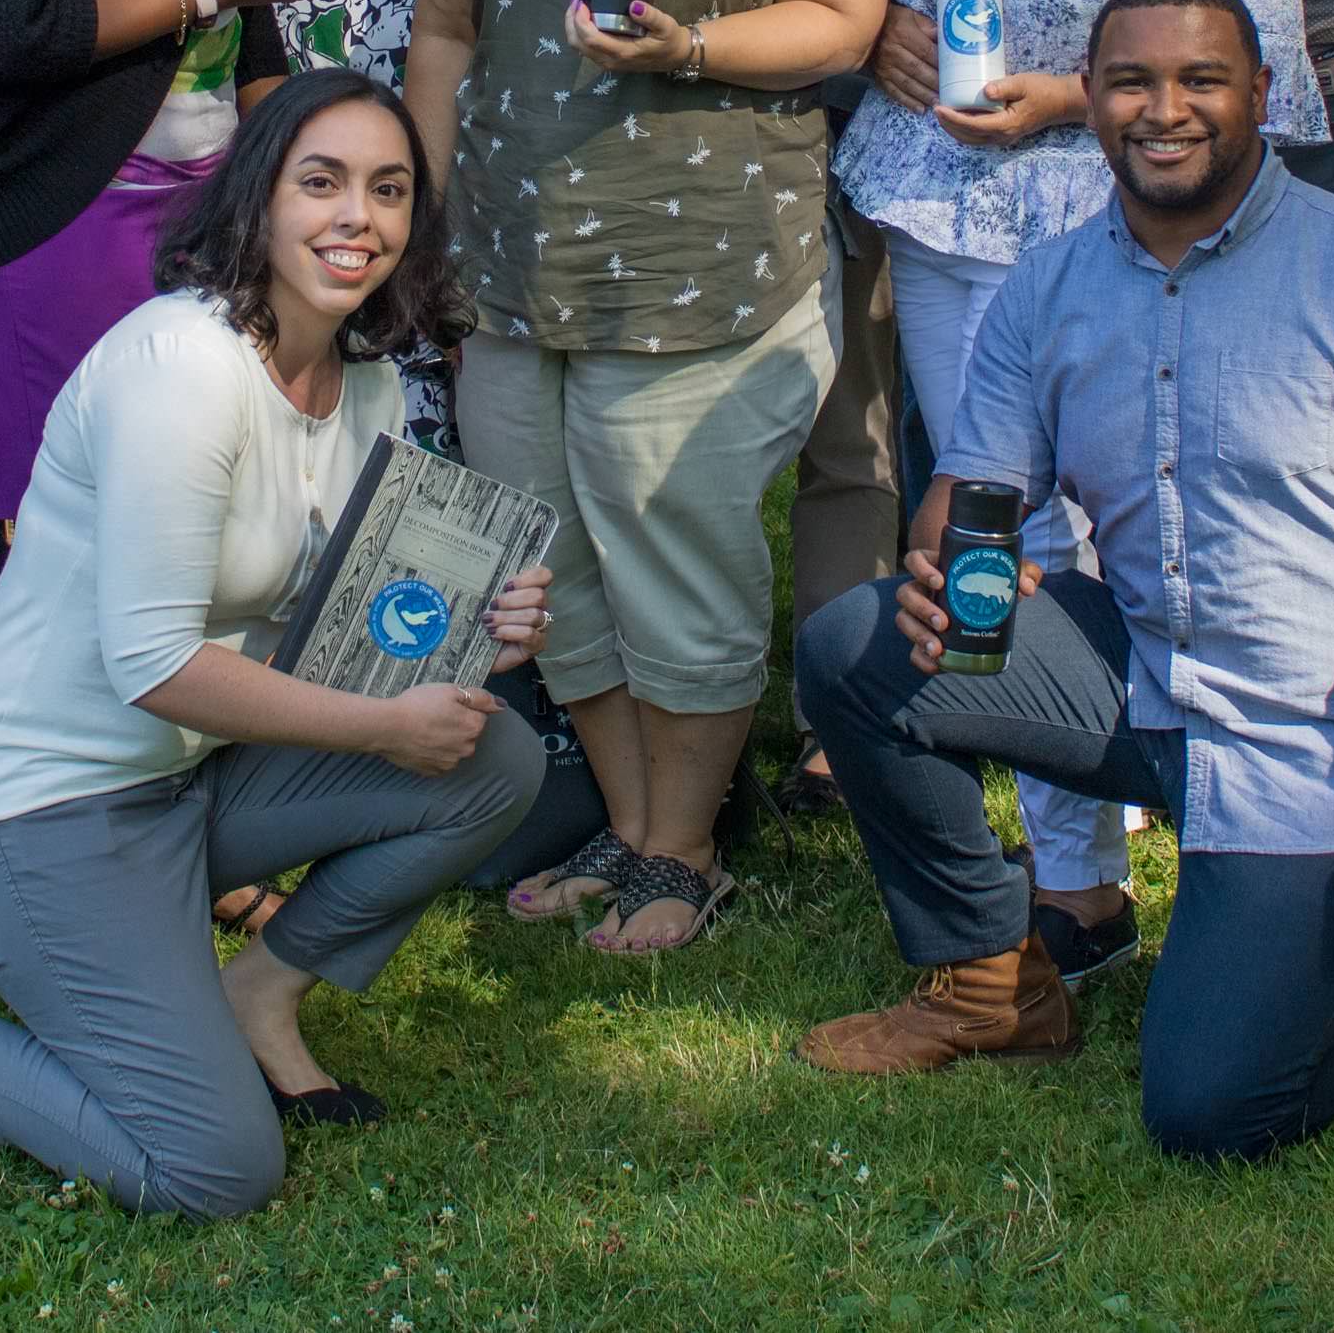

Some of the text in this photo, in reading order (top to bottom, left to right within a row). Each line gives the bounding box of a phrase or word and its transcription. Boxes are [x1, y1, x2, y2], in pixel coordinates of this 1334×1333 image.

[404, 516, 468, 547] DECOMPOSITION
[469, 543, 492, 558] BOOK
[953, 552, 981, 575] PROTECT
[982, 551, 998, 559] OUR
[384, 582, 418, 598] PROTECT
[419, 584, 434, 597] OUR
